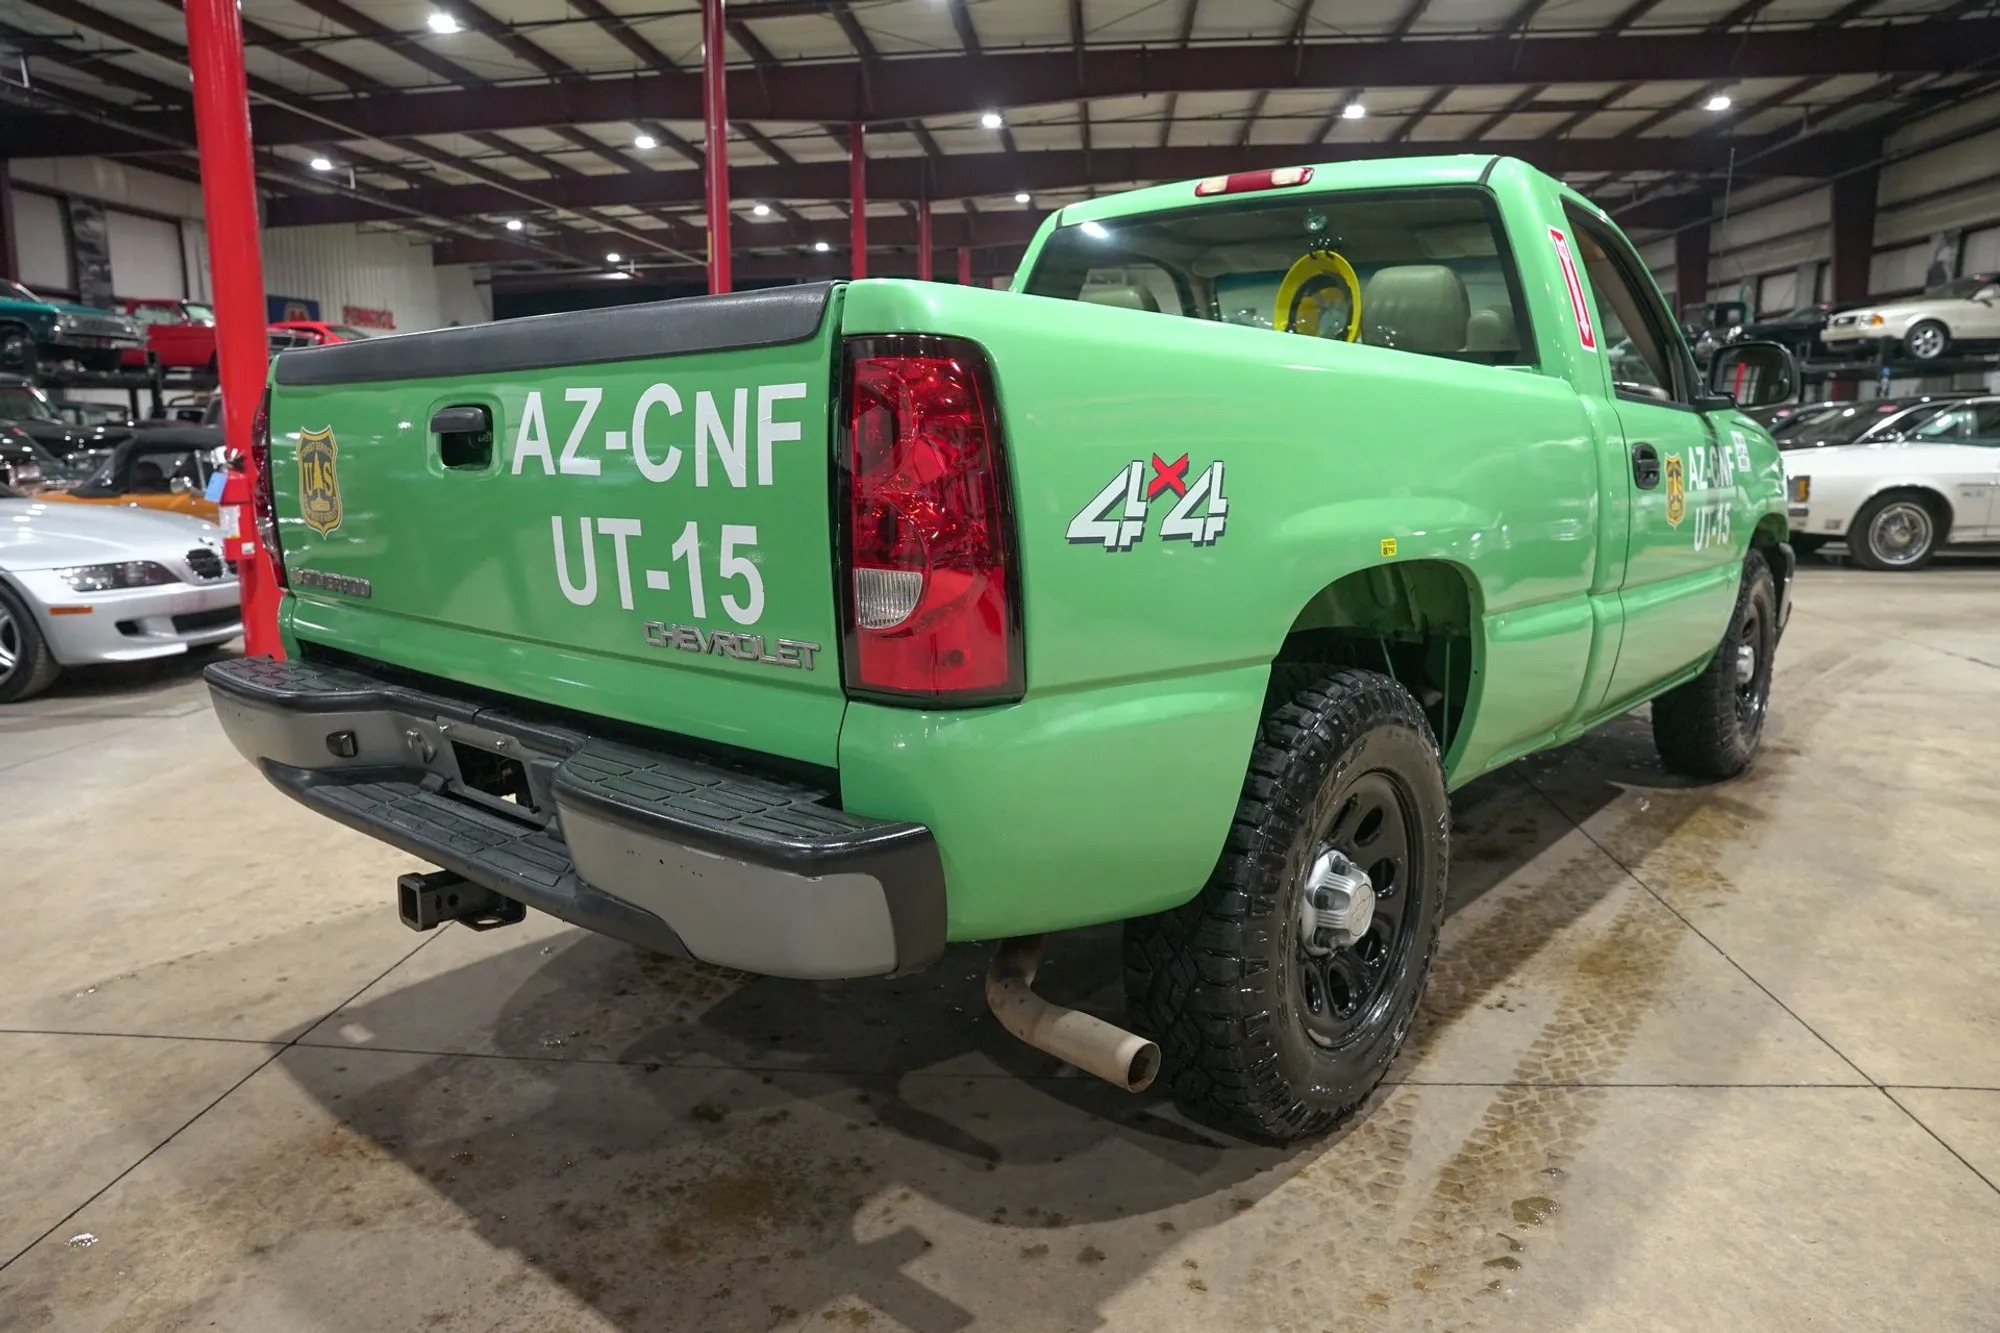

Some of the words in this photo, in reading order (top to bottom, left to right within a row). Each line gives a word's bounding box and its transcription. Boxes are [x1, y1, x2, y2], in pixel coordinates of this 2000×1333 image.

[511, 382, 807, 488] AZ-CNF
[1688, 446, 1735, 492] AZ-CNF
[1694, 501, 1732, 552] UT-15
[551, 515, 765, 626] UT-15
[643, 620, 821, 671] CHEVROLET
